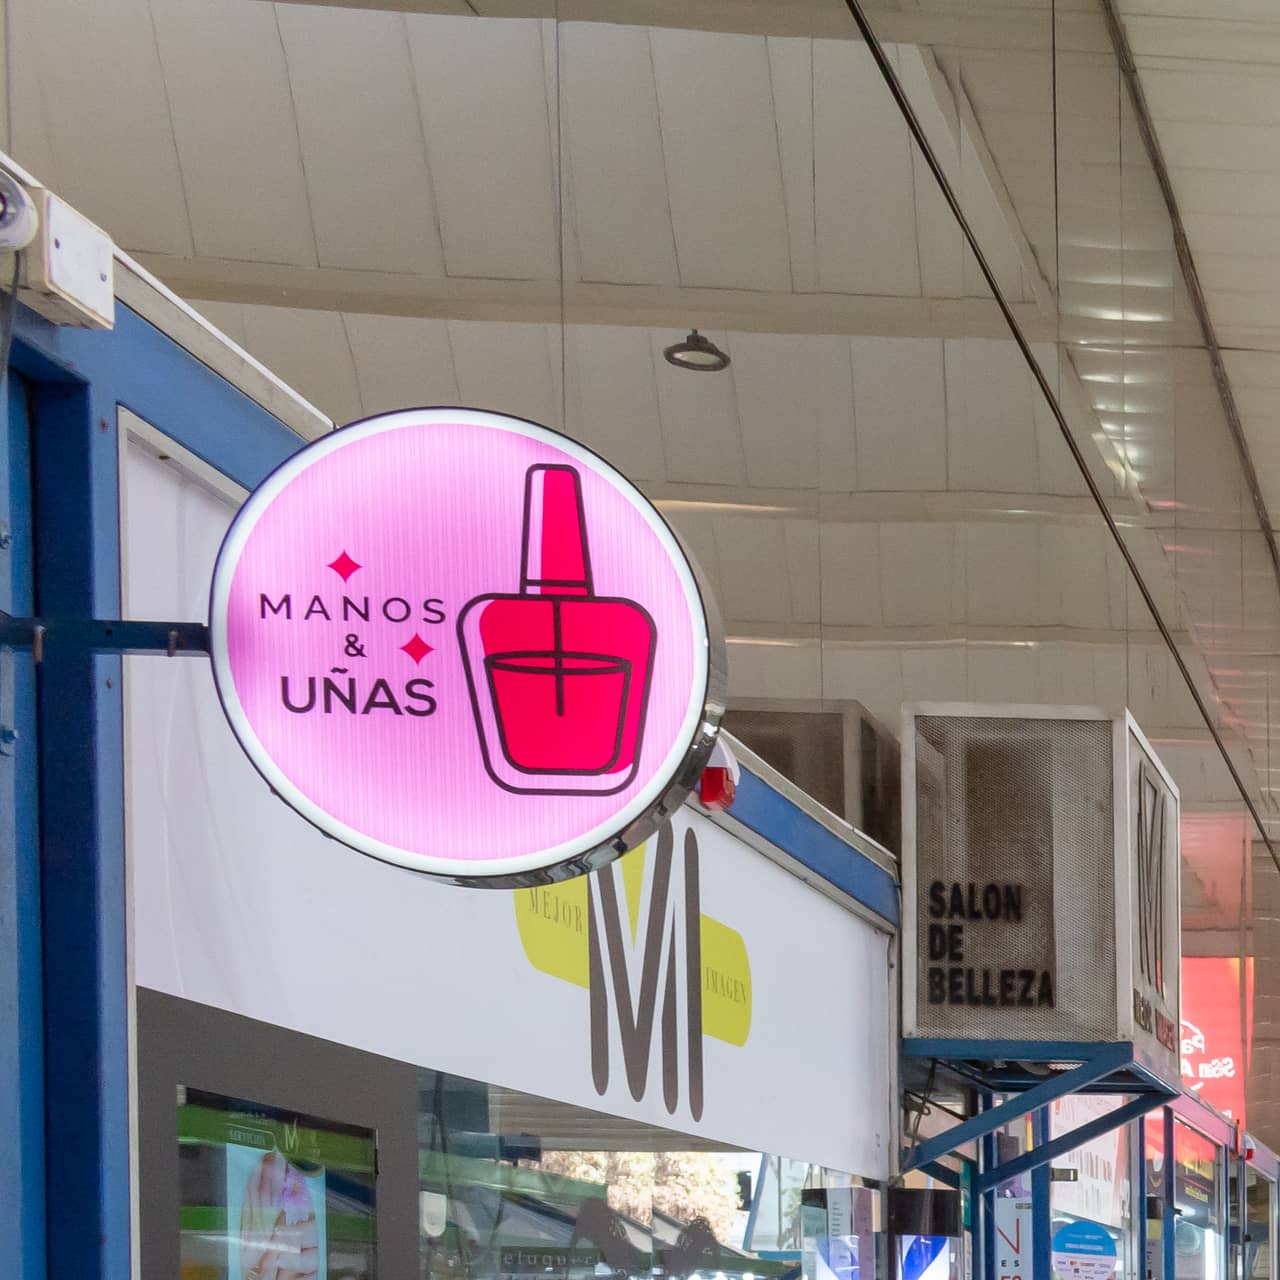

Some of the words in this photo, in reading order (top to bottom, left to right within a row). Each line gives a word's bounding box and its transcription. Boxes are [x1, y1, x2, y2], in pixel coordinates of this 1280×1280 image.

[260, 594, 447, 626] MANOS
[344, 633, 368, 659] &
[280, 665, 438, 718] UÑAS
[928, 880, 1024, 923] SALON
[928, 924, 964, 962] DE
[704, 966, 748, 1007] IMAGEN
[927, 967, 1056, 1008] BELLEZA
